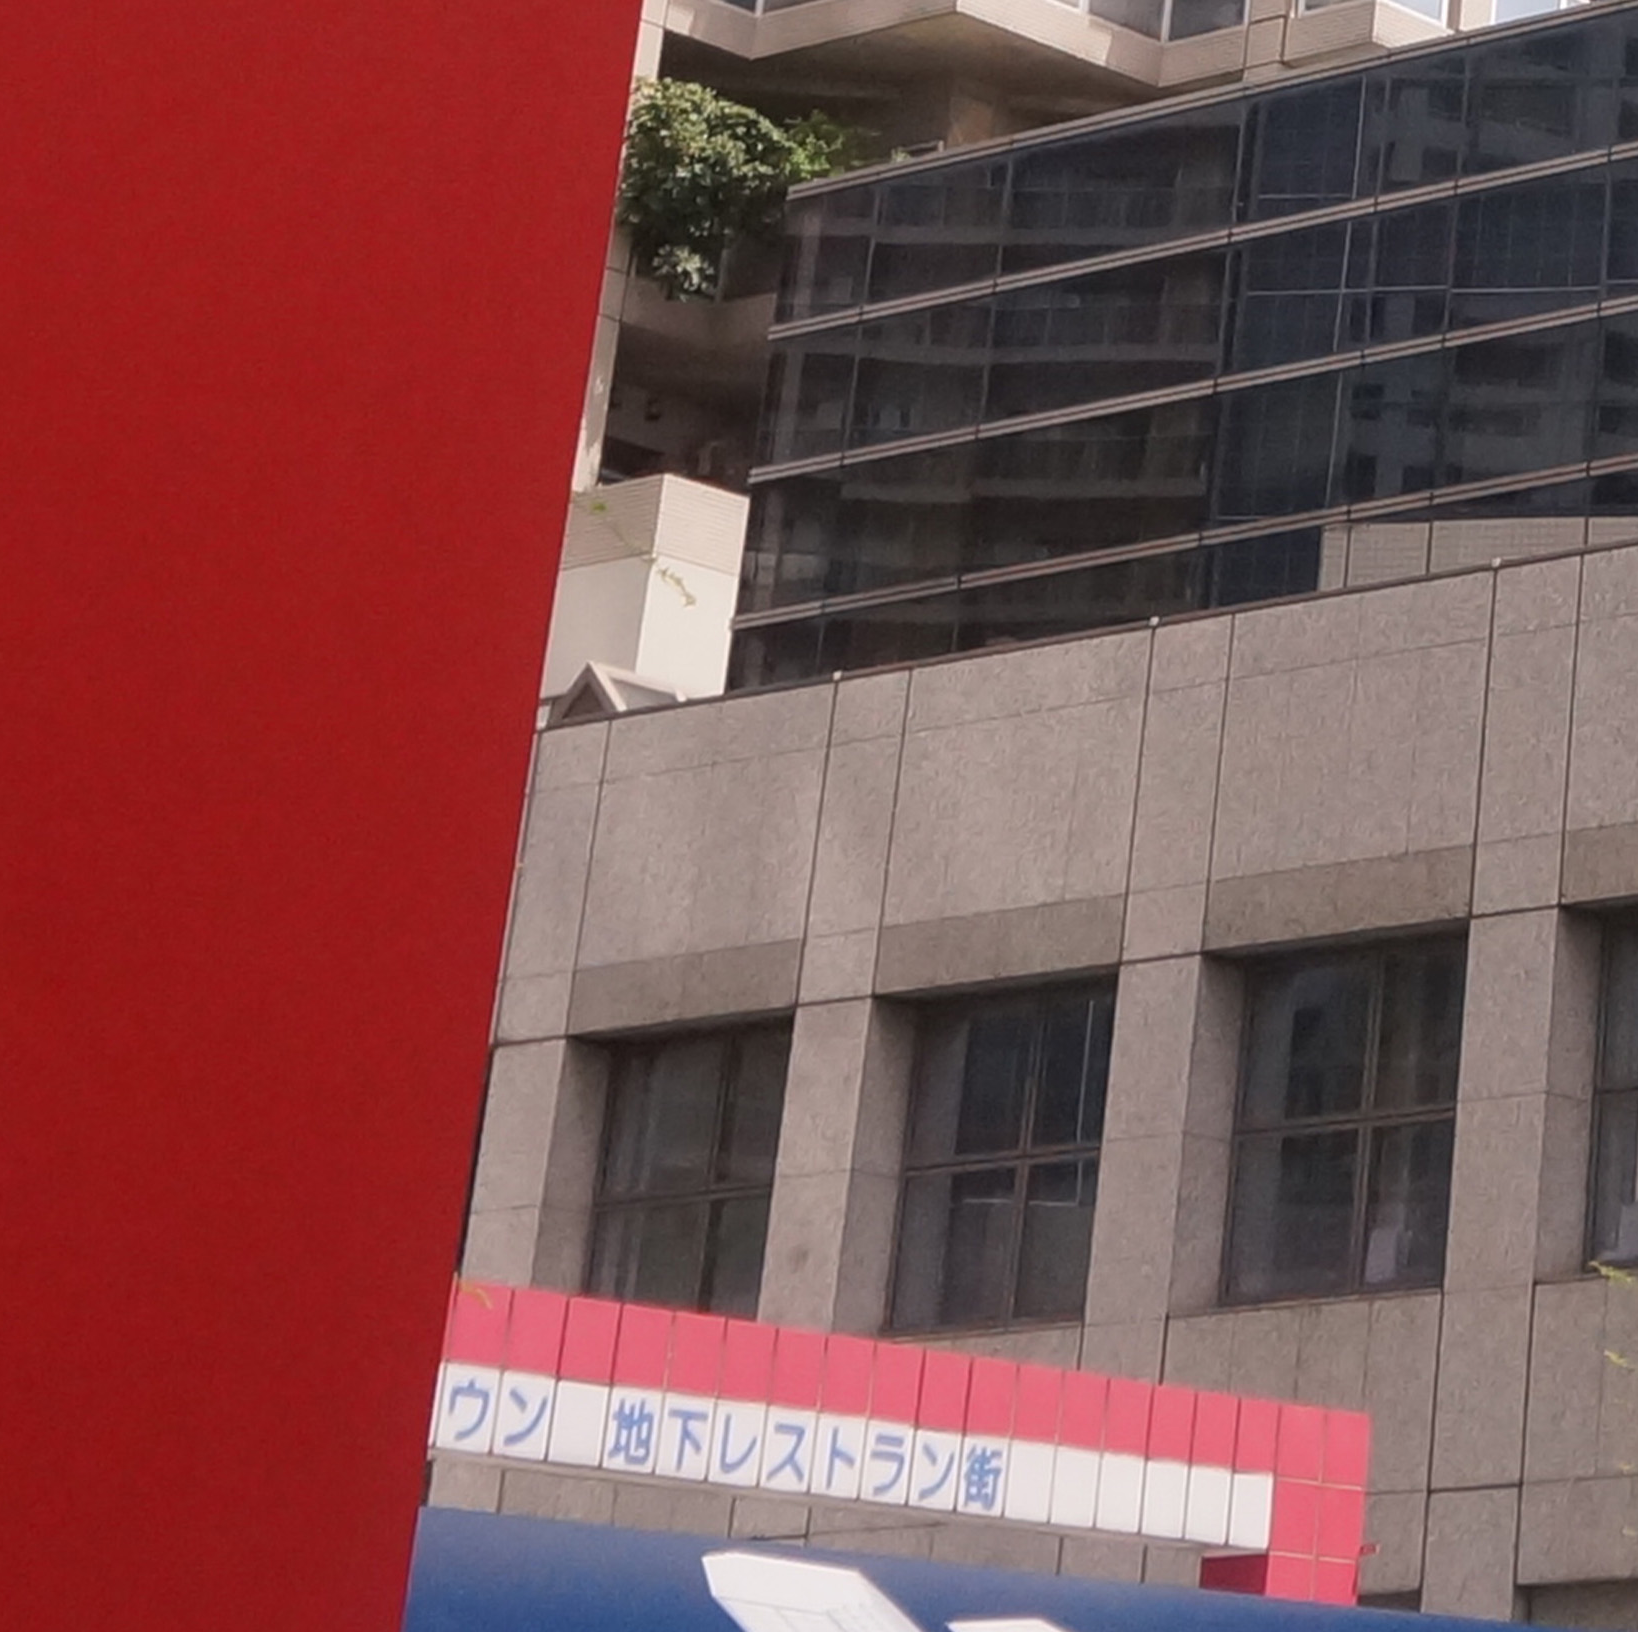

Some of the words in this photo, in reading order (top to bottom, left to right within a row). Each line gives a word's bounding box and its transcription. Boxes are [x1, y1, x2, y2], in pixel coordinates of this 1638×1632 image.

[608, 1397, 1003, 1512] 地下レストラン街
